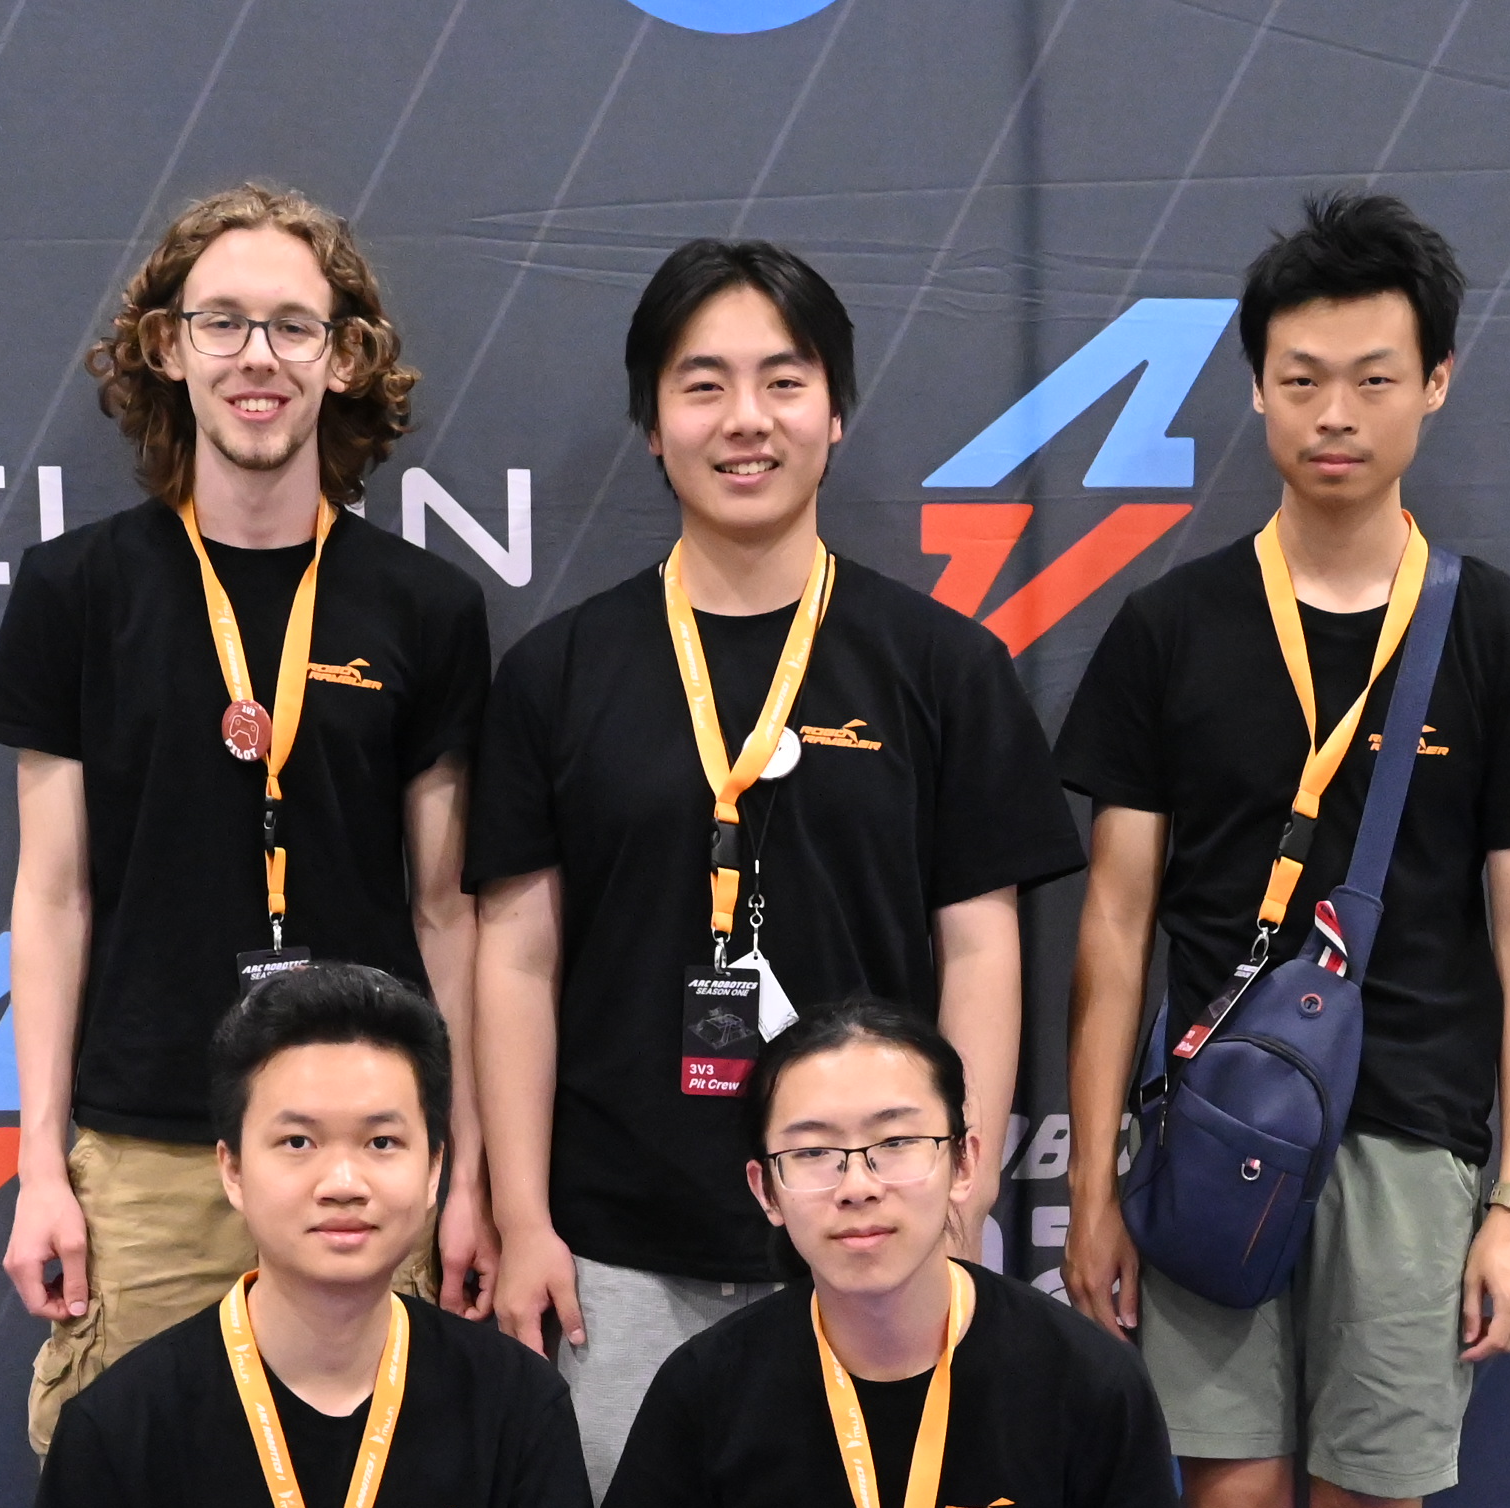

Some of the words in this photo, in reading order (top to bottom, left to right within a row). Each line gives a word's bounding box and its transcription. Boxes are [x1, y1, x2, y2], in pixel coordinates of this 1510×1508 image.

[225, 738, 258, 760] PILOT
[688, 979, 711, 988] ARC
[710, 979, 759, 990] ROBOTICS
[695, 987, 731, 996] SEASON
[730, 988, 750, 997] ONE
[689, 1063, 715, 1075] 3V3
[688, 1078, 707, 1090] Pit
[707, 1078, 740, 1091] Crew
